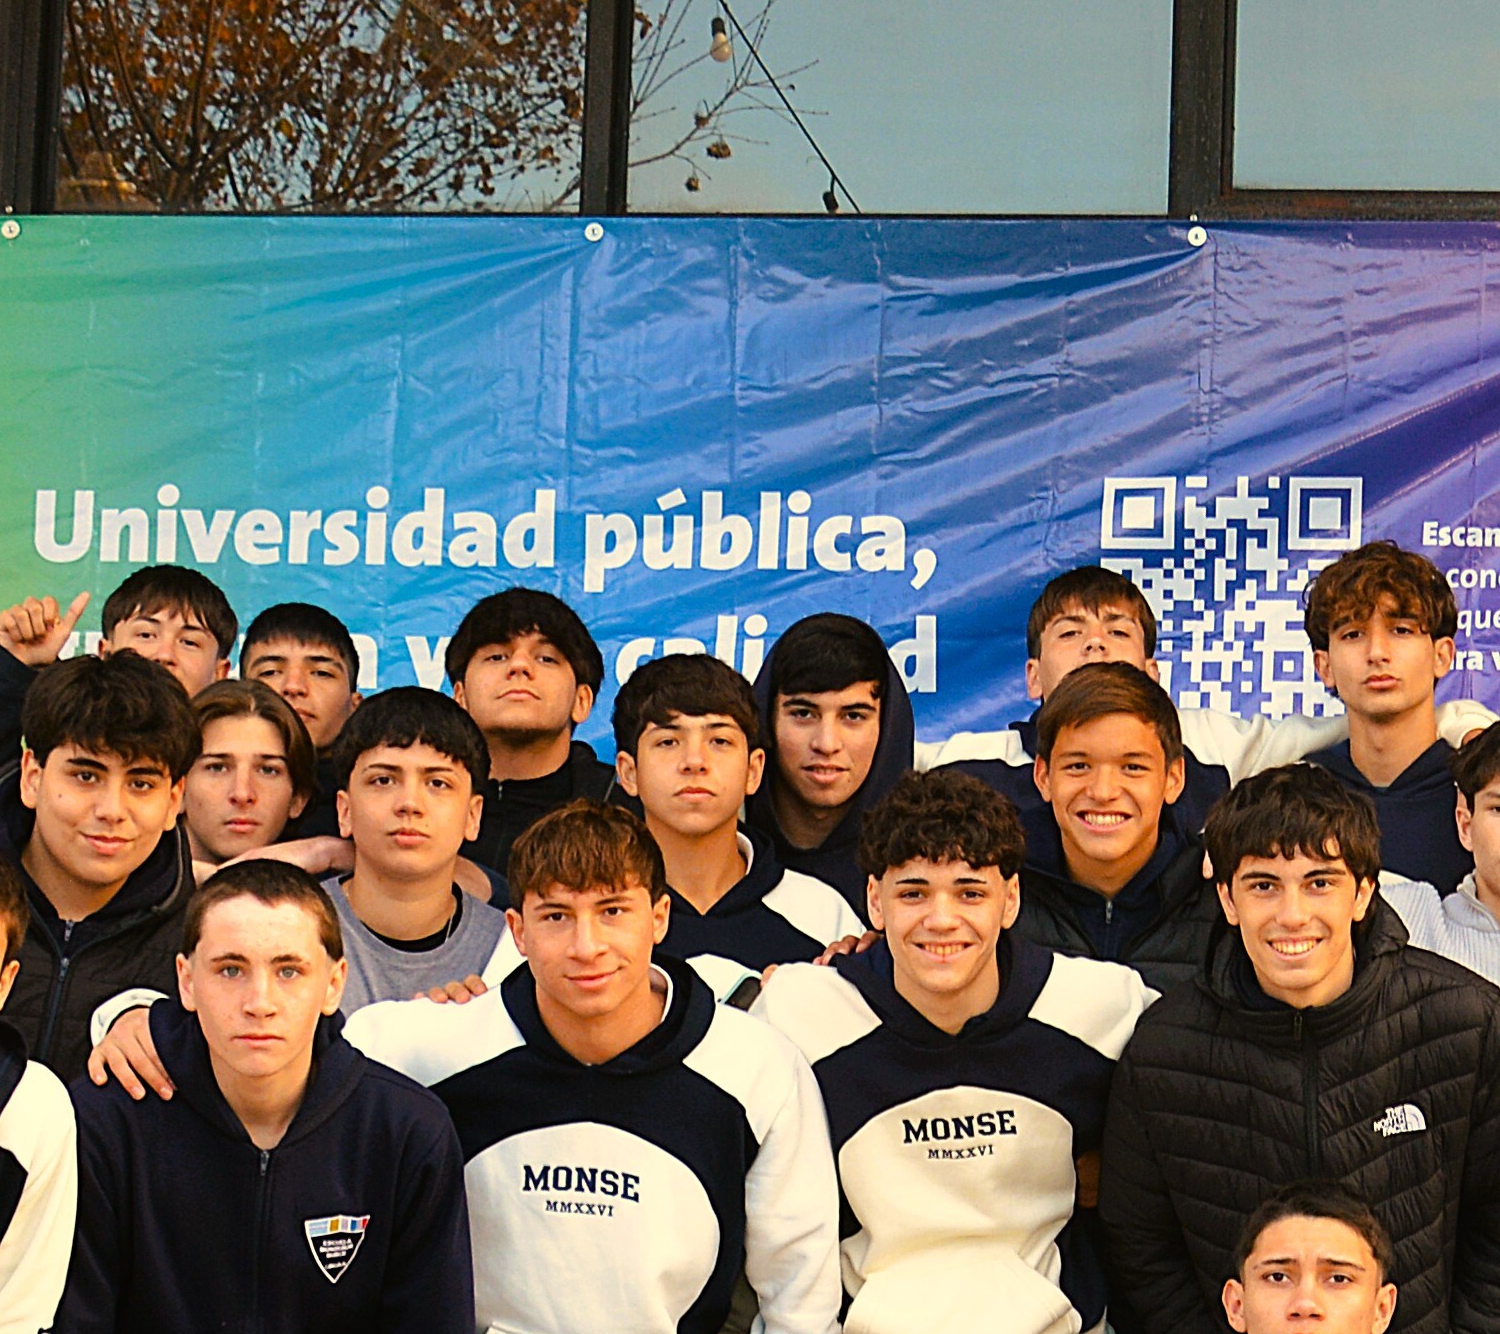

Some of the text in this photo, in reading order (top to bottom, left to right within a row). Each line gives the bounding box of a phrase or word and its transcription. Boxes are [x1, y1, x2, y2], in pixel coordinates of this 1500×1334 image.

[33, 483, 938, 593] Universidad pública,
[902, 1110, 1017, 1144] MONSE
[928, 1144, 994, 1160] MMXXVI
[522, 1165, 640, 1203] MONSE
[545, 1200, 614, 1217] MMXXVI
